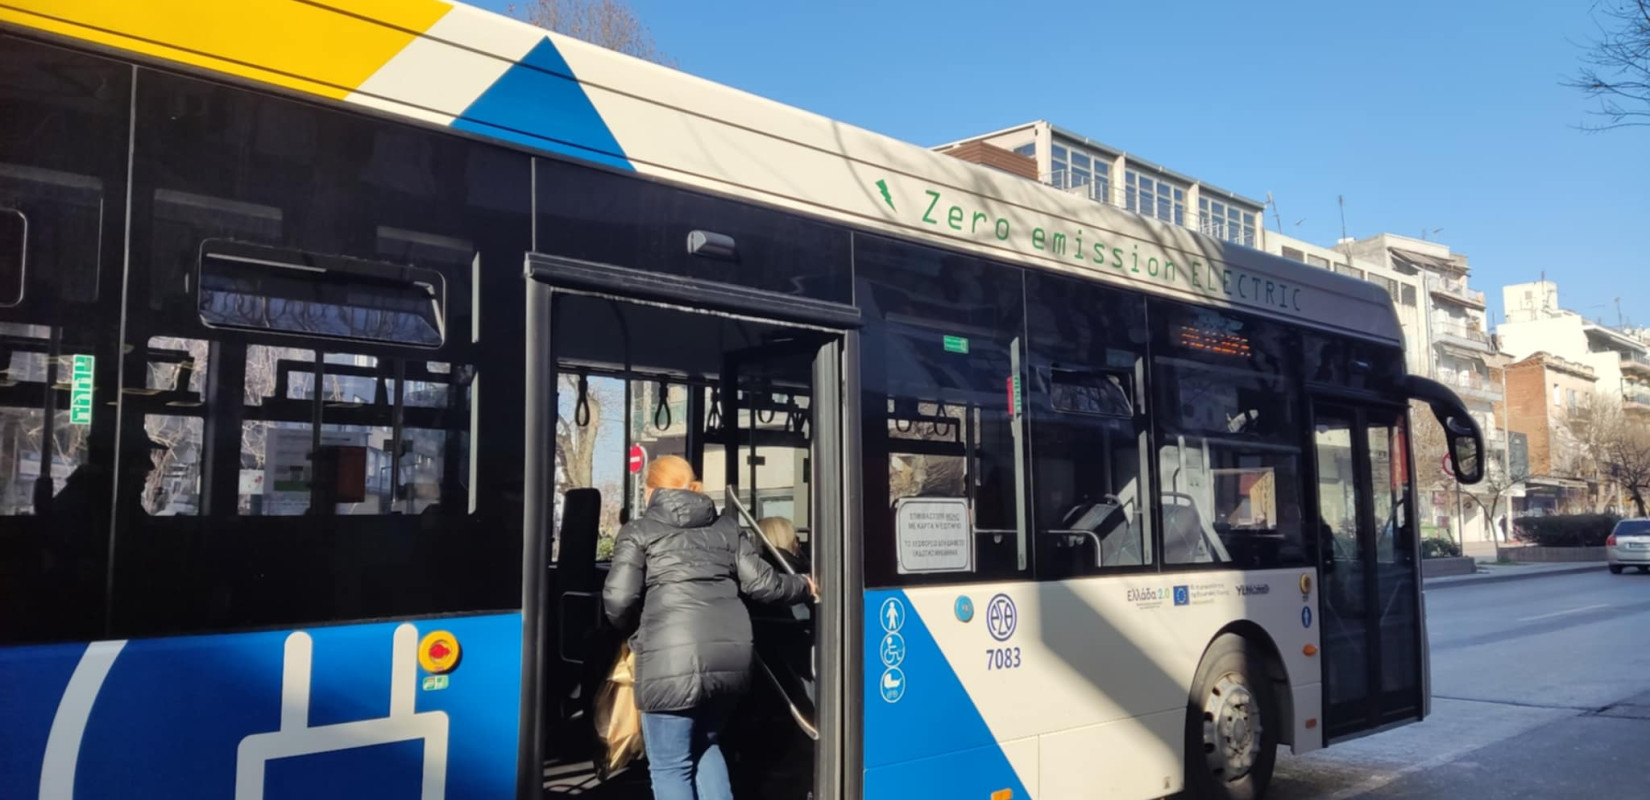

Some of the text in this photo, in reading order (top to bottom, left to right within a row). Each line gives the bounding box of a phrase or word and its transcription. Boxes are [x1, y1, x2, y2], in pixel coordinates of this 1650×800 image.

[921, 189, 1301, 312] Zero emission ELECTRIC
[1127, 587, 1157, 602] Ελλάδα
[986, 646, 1022, 671] 7083
